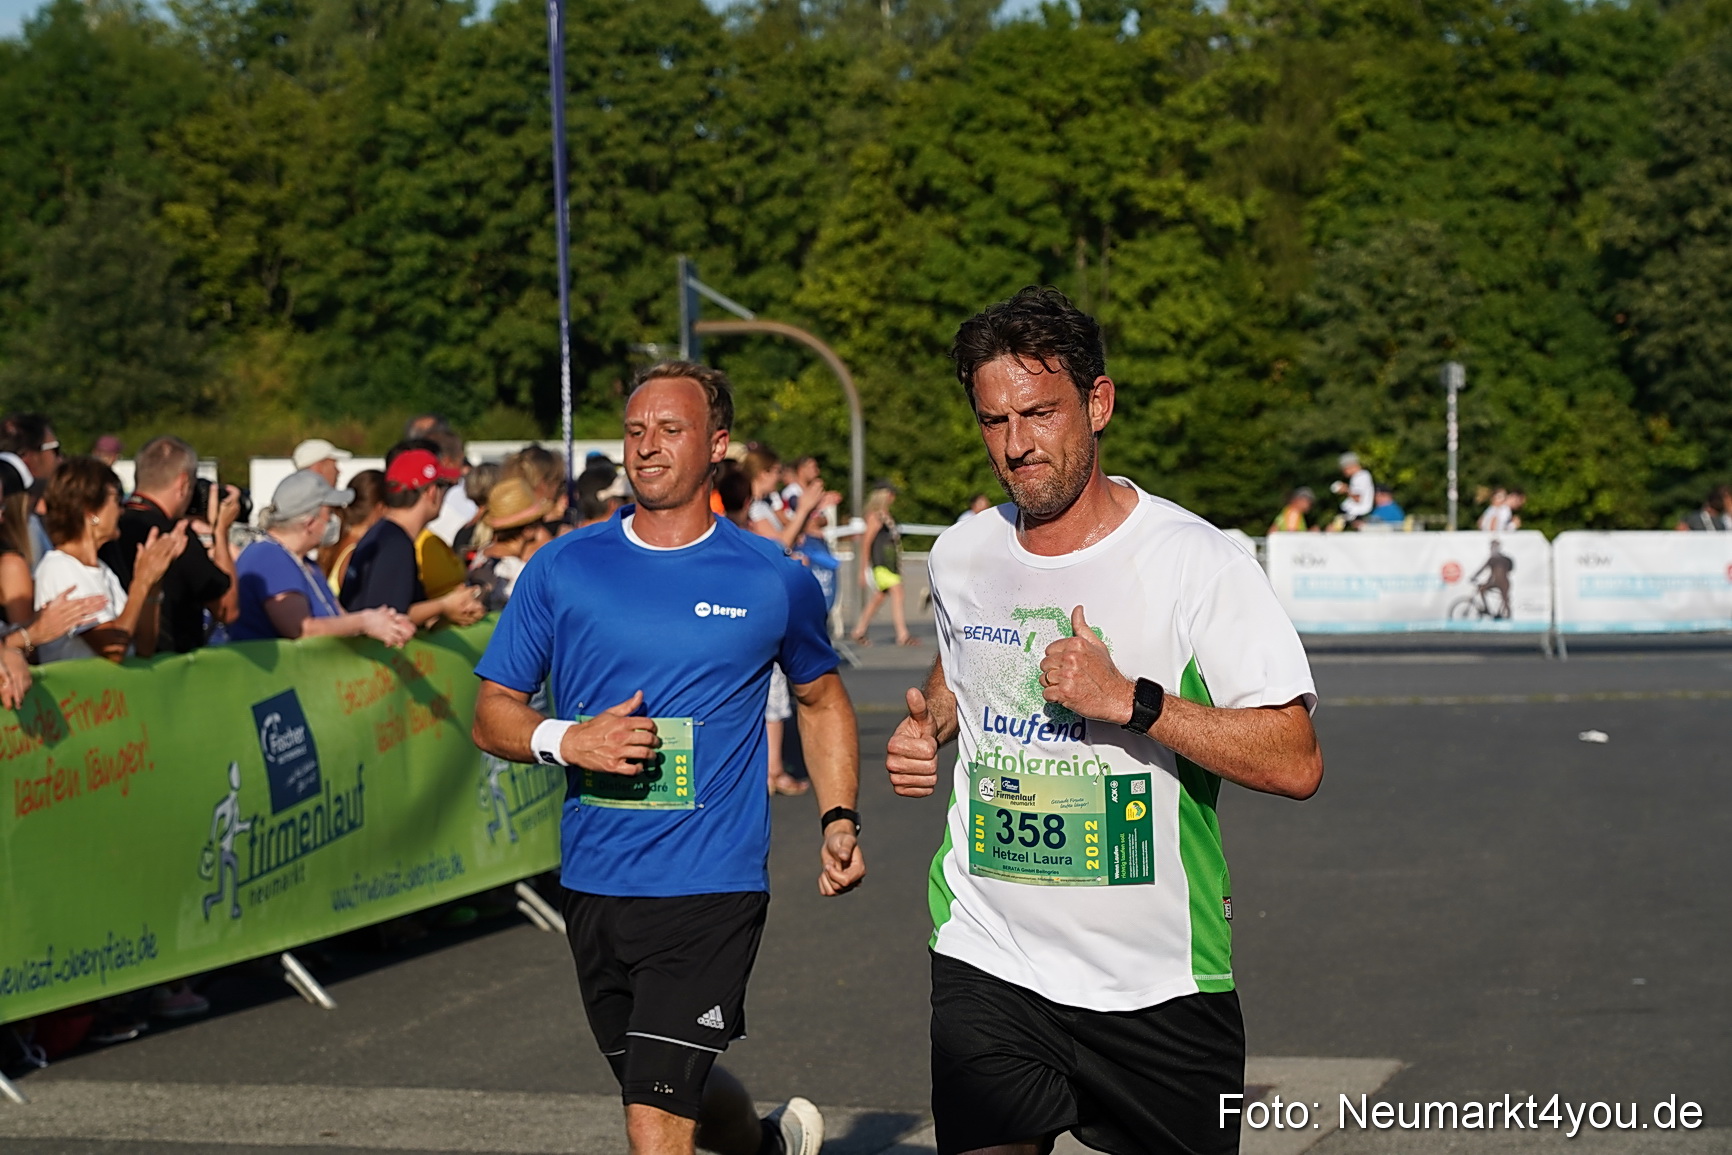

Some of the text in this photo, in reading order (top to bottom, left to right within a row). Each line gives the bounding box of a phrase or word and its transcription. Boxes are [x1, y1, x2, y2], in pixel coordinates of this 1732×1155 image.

[712, 604, 748, 619] Berger
[963, 625, 1022, 647] BERATA
[983, 705, 1087, 745] Laufend
[675, 754, 688, 797] 2022
[996, 790, 1036, 802] Firmenlauf
[1111, 788, 1119, 803] AOK
[248, 762, 365, 883] firmenlauf
[975, 814, 985, 853] RUN
[995, 808, 1067, 850] 358
[992, 845, 1073, 866] Hetzel Laura
[1084, 820, 1100, 870] 2022
[1002, 864, 1021, 872] BERATA
[697, 1016, 725, 1030] adidas
